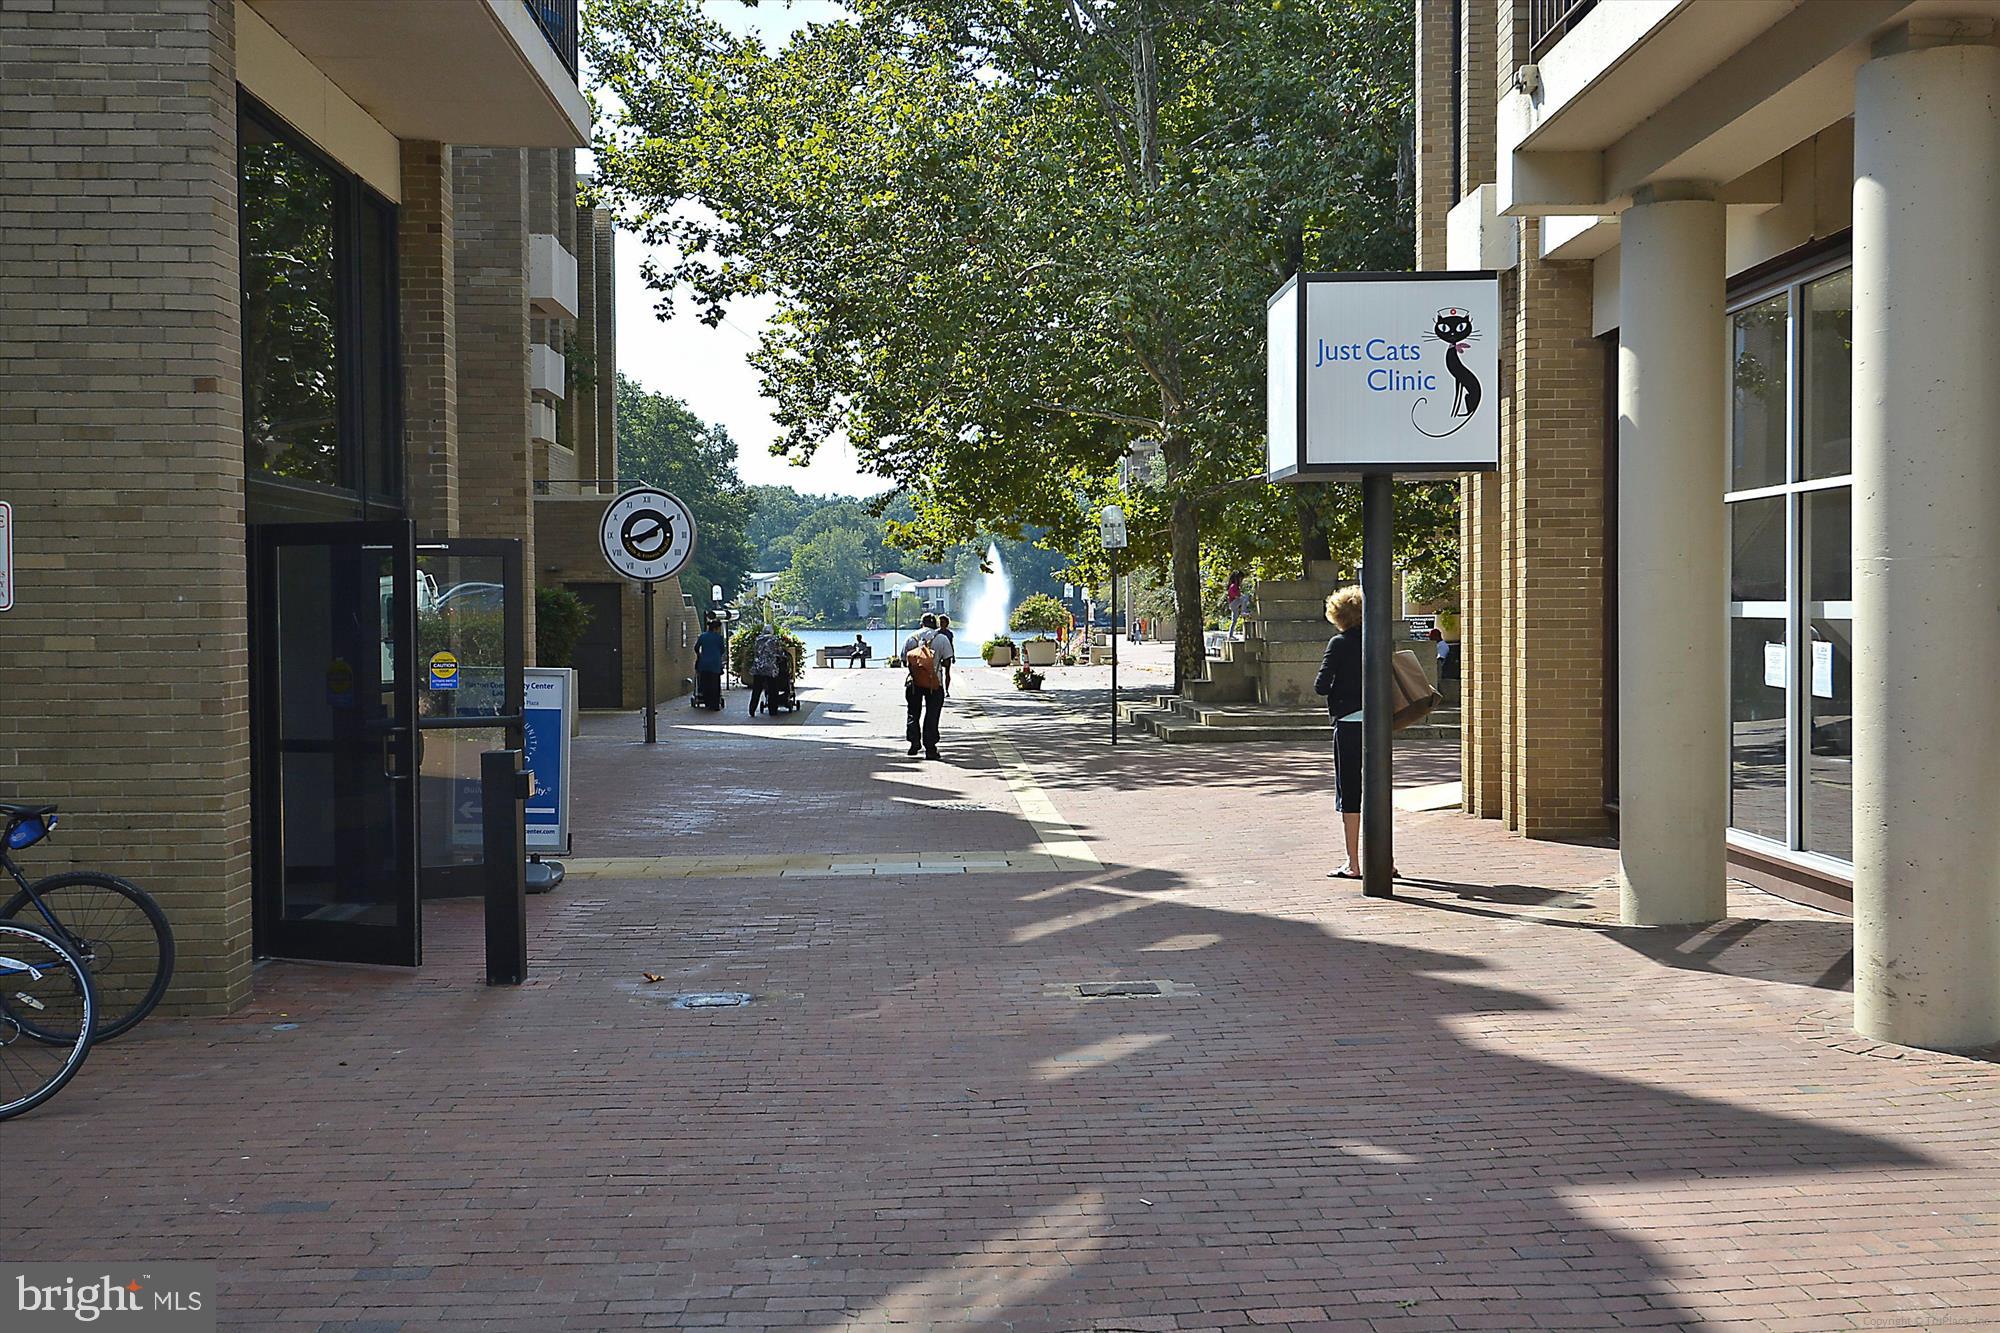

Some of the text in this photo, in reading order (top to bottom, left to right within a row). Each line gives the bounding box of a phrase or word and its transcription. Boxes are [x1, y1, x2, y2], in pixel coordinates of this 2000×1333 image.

[1315, 338, 1421, 367] Just Cats
[1367, 369, 1436, 391] Clinic
